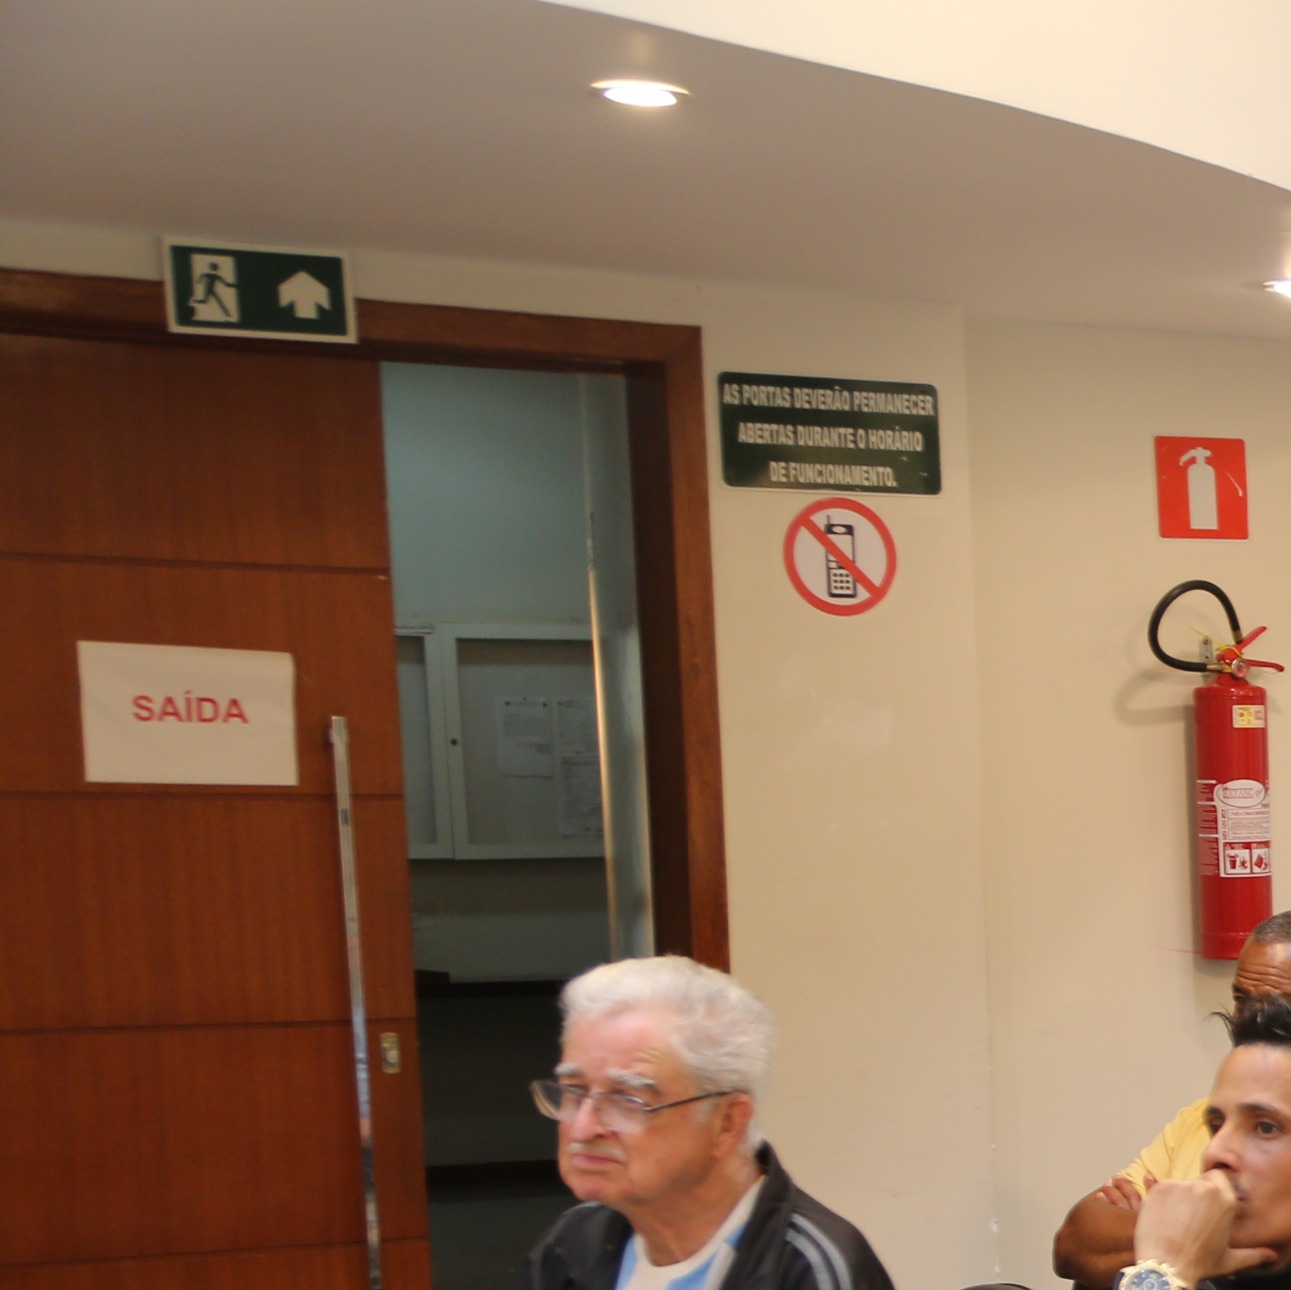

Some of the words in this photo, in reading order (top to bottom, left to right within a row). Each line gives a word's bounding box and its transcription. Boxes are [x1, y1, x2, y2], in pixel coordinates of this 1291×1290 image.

[723, 384, 739, 404] AS
[743, 385, 789, 408] PORTAS
[793, 386, 850, 411] DEVERÃO
[853, 392, 935, 416] PERMANECER
[738, 423, 794, 445] ABERTAS
[797, 426, 854, 448] DURANTE
[857, 430, 864, 449] O
[869, 426, 923, 451] HORÁRIO
[770, 461, 786, 482] DE
[789, 463, 898, 487] FUNCIONAMENTO.
[132, 690, 249, 724] SAÍDA
